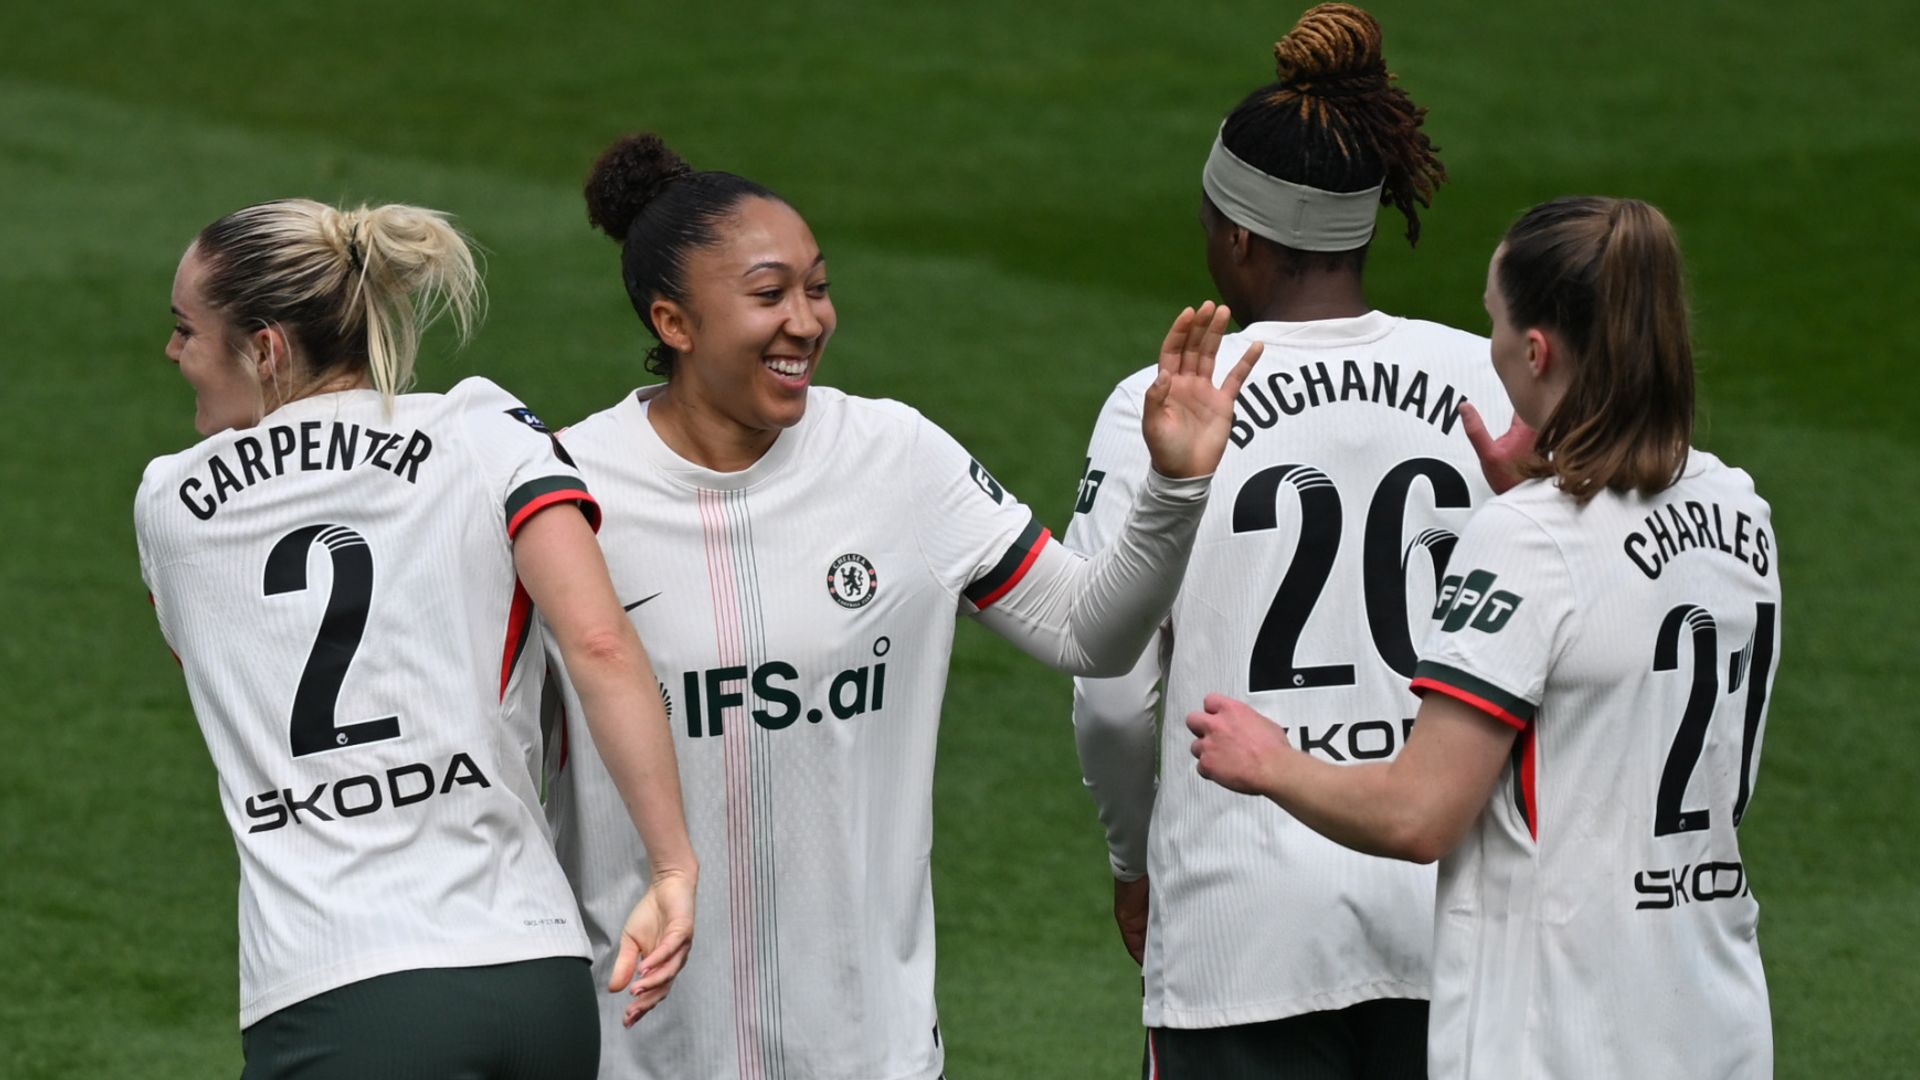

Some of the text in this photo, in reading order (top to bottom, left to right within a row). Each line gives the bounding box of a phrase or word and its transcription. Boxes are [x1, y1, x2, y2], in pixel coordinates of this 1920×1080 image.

[1228, 360, 1467, 450] BUCHANAN
[178, 421, 432, 521] CARPENTER
[1232, 457, 1471, 692] 26
[1624, 500, 1770, 580] CHARLES
[263, 524, 401, 757] 2
[1435, 582, 1516, 625] FPT
[683, 636, 891, 738] IFS.ai
[1652, 602, 1776, 838] 21
[245, 752, 492, 834] SKODA
[1634, 861, 1749, 910] SKOD
